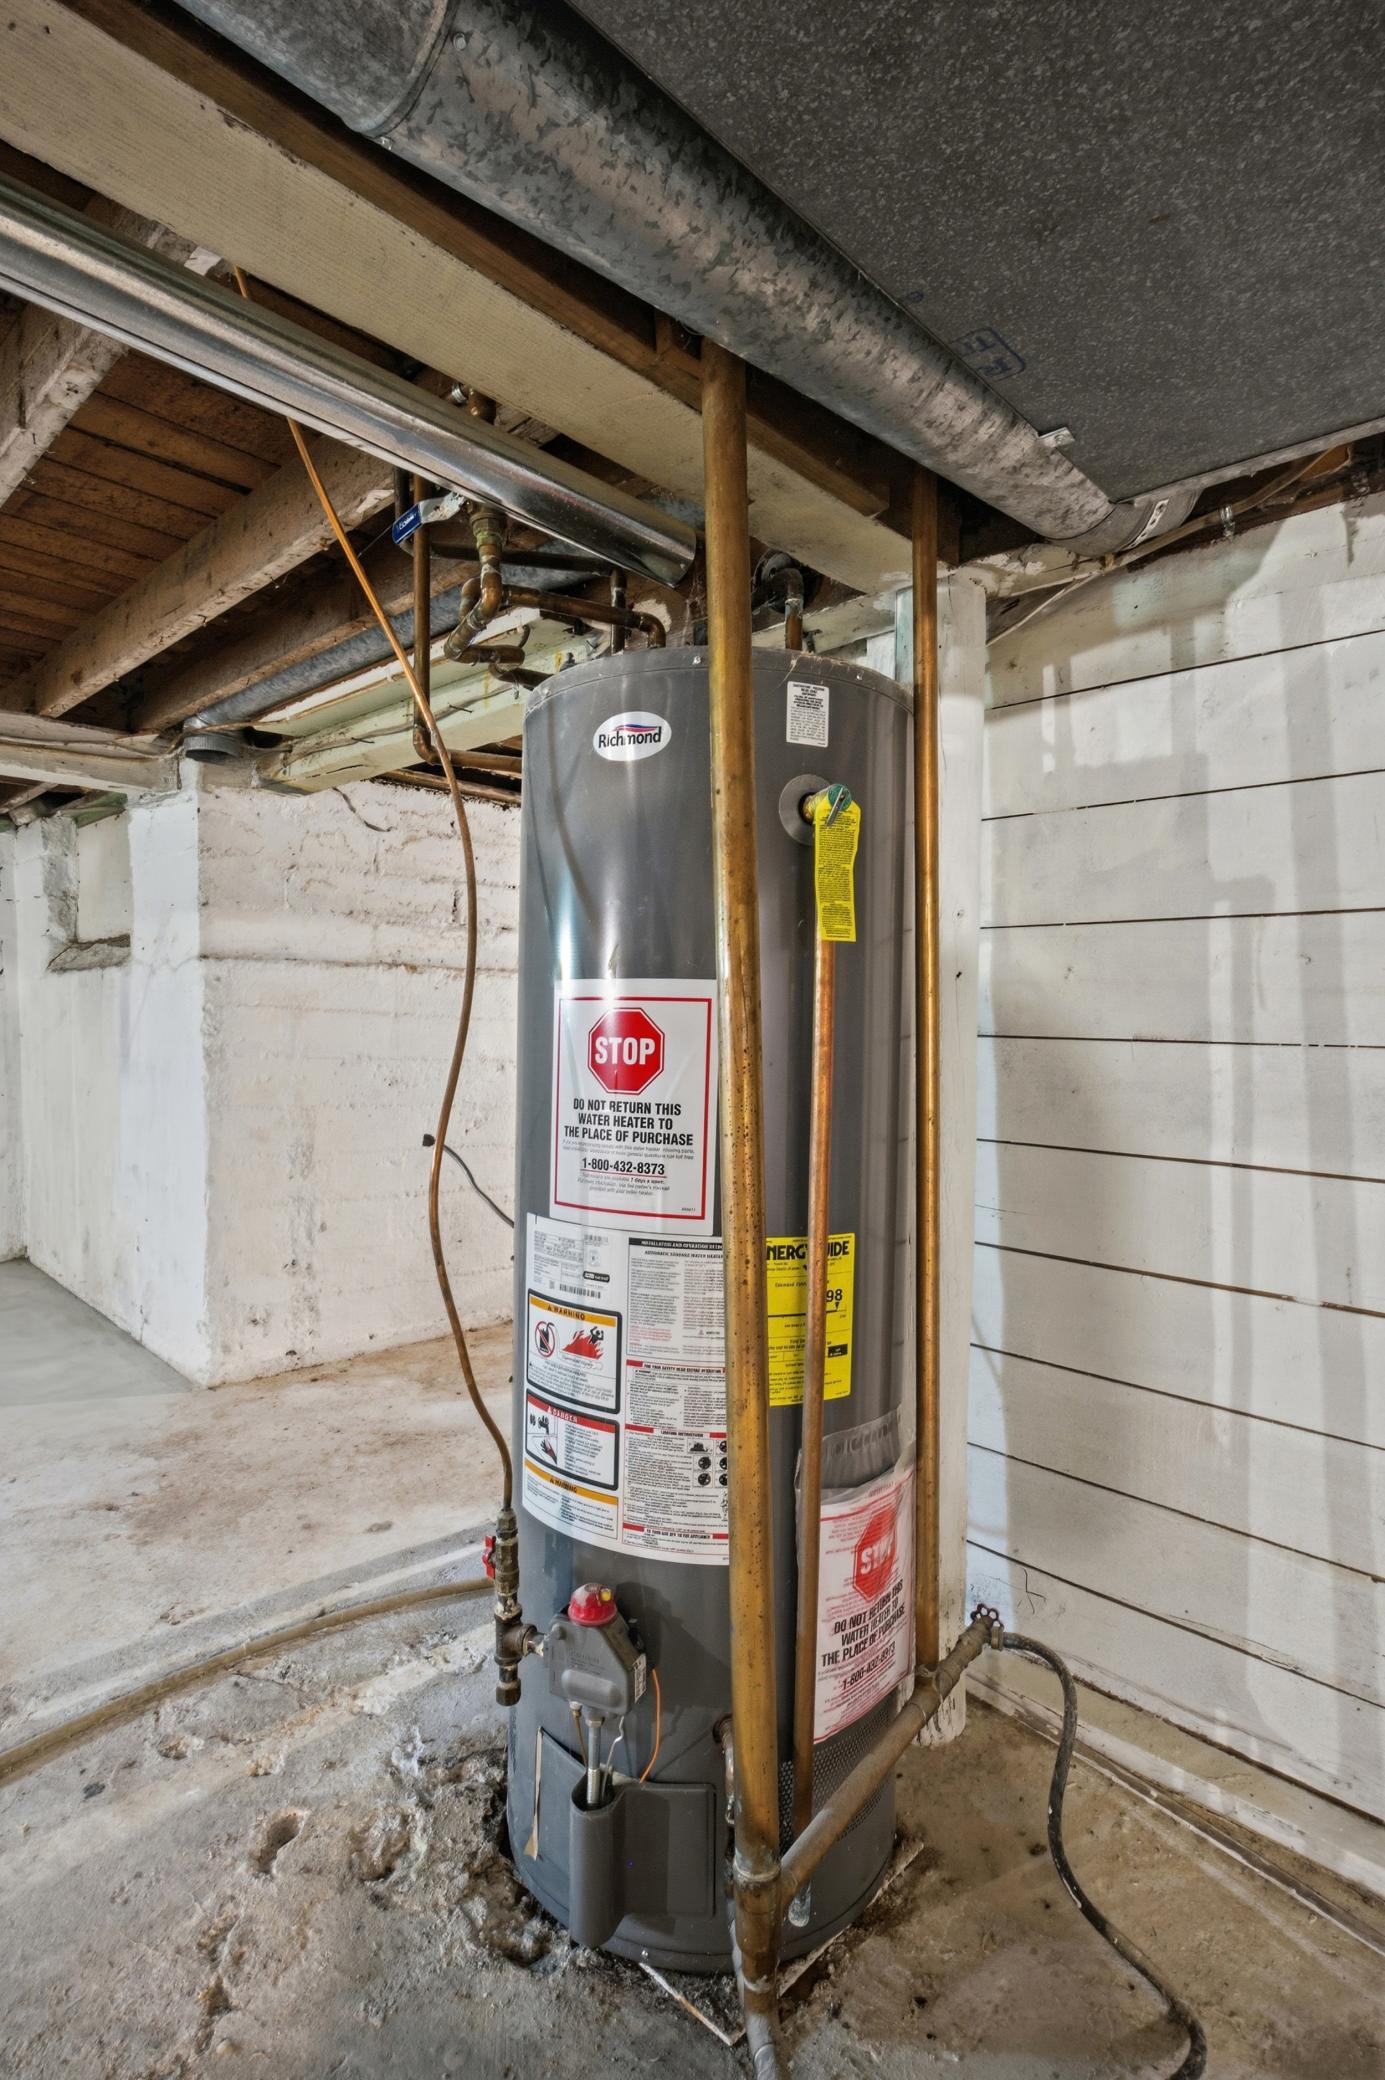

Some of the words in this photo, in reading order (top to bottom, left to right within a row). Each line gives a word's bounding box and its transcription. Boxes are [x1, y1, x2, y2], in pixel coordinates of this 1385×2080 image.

[598, 726, 662, 748] Richmond
[594, 1036, 656, 1065] STOP
[573, 1098, 585, 1110] DO
[587, 1099, 606, 1111] NOT
[609, 1101, 651, 1114] RETURN
[655, 1103, 682, 1116] THIS
[578, 1113, 610, 1127] WATER
[613, 1115, 655, 1129] HEATER
[658, 1118, 673, 1130] TO
[564, 1126, 580, 1138] THE
[582, 1127, 613, 1141] PLACE
[615, 1130, 629, 1142] OF
[632, 1131, 694, 1146] PURCHASE
[582, 1157, 665, 1175] 1-800-432-8373
[553, 1307, 586, 1321] WARNING
[552, 1408, 578, 1423] DANGER
[833, 1620, 847, 1635] DO
[849, 1611, 867, 1629] NOT
[841, 1625, 869, 1647] WATER
[821, 1650, 840, 1667] THE
[842, 1636, 868, 1660] PLACE
[868, 1631, 877, 1647] OF
